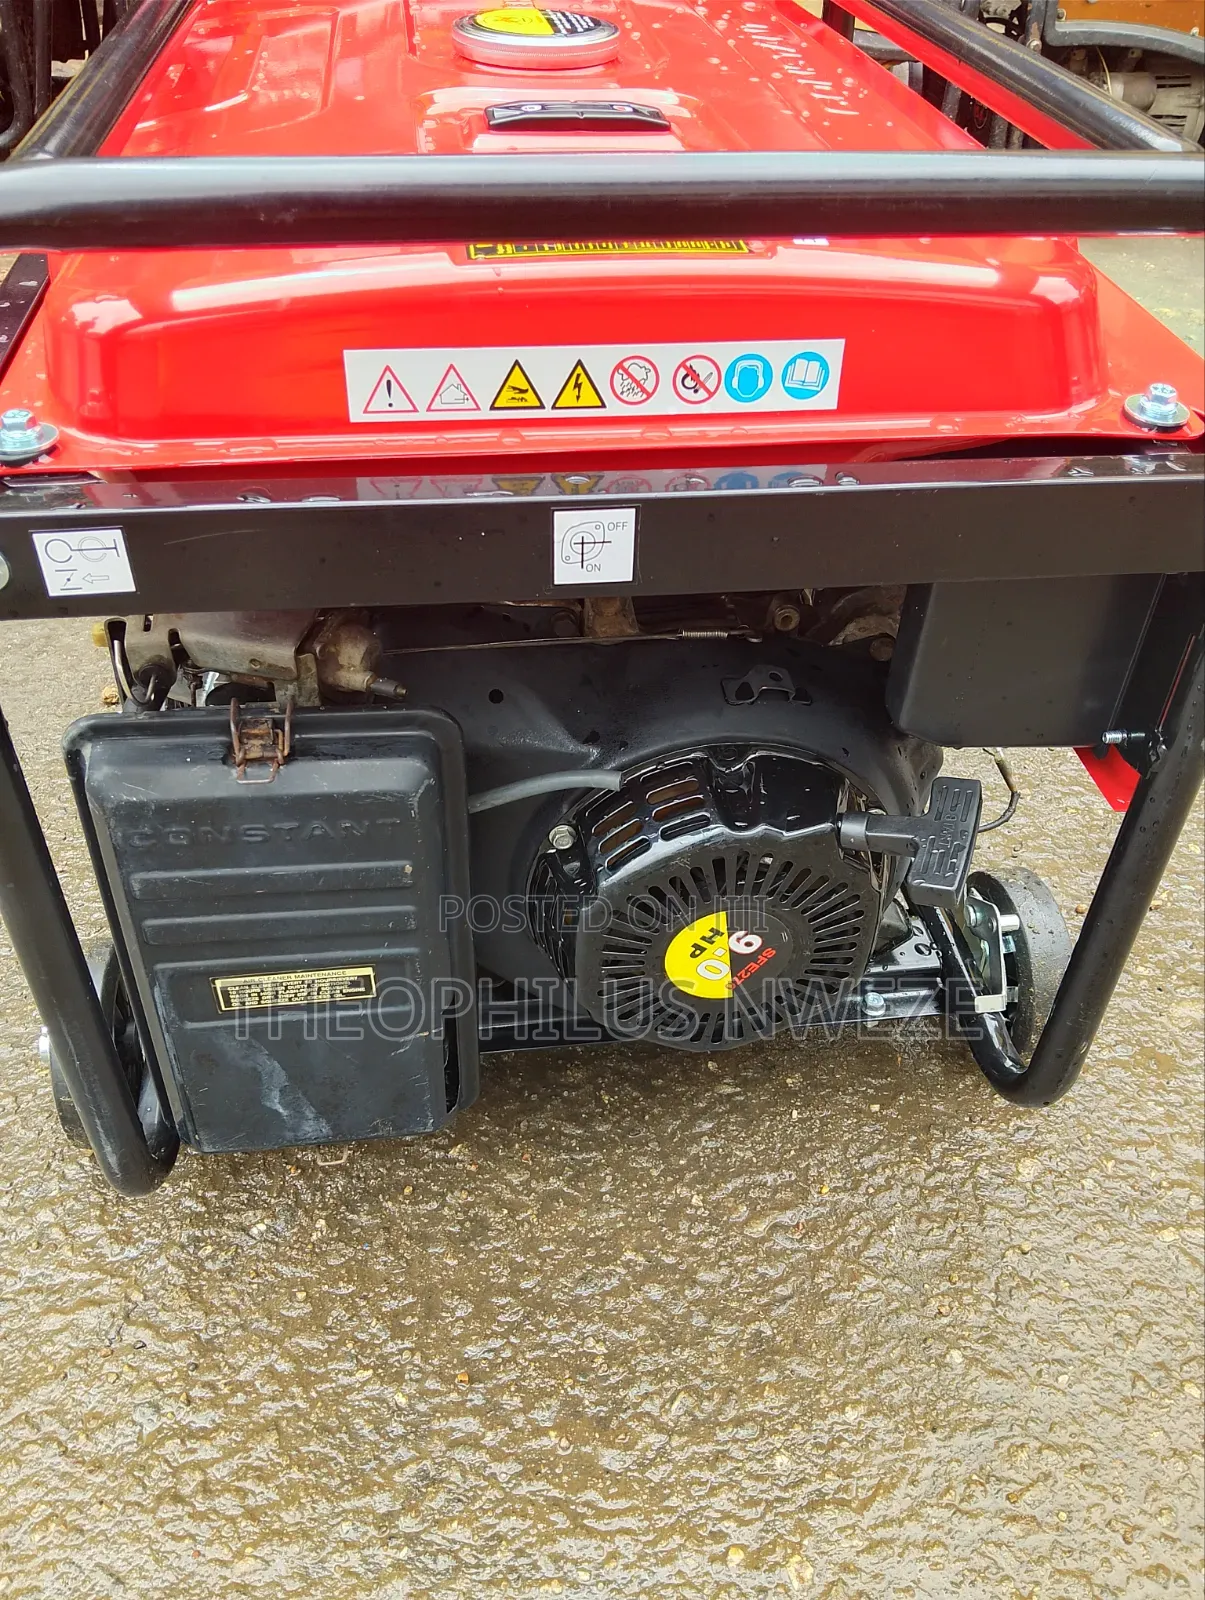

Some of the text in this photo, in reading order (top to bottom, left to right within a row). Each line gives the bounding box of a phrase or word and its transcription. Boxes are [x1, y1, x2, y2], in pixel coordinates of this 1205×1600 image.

[607, 521, 628, 532] OFF
[585, 563, 602, 573] ON
[127, 817, 402, 851] CONSTANT
[689, 926, 726, 959] HP
